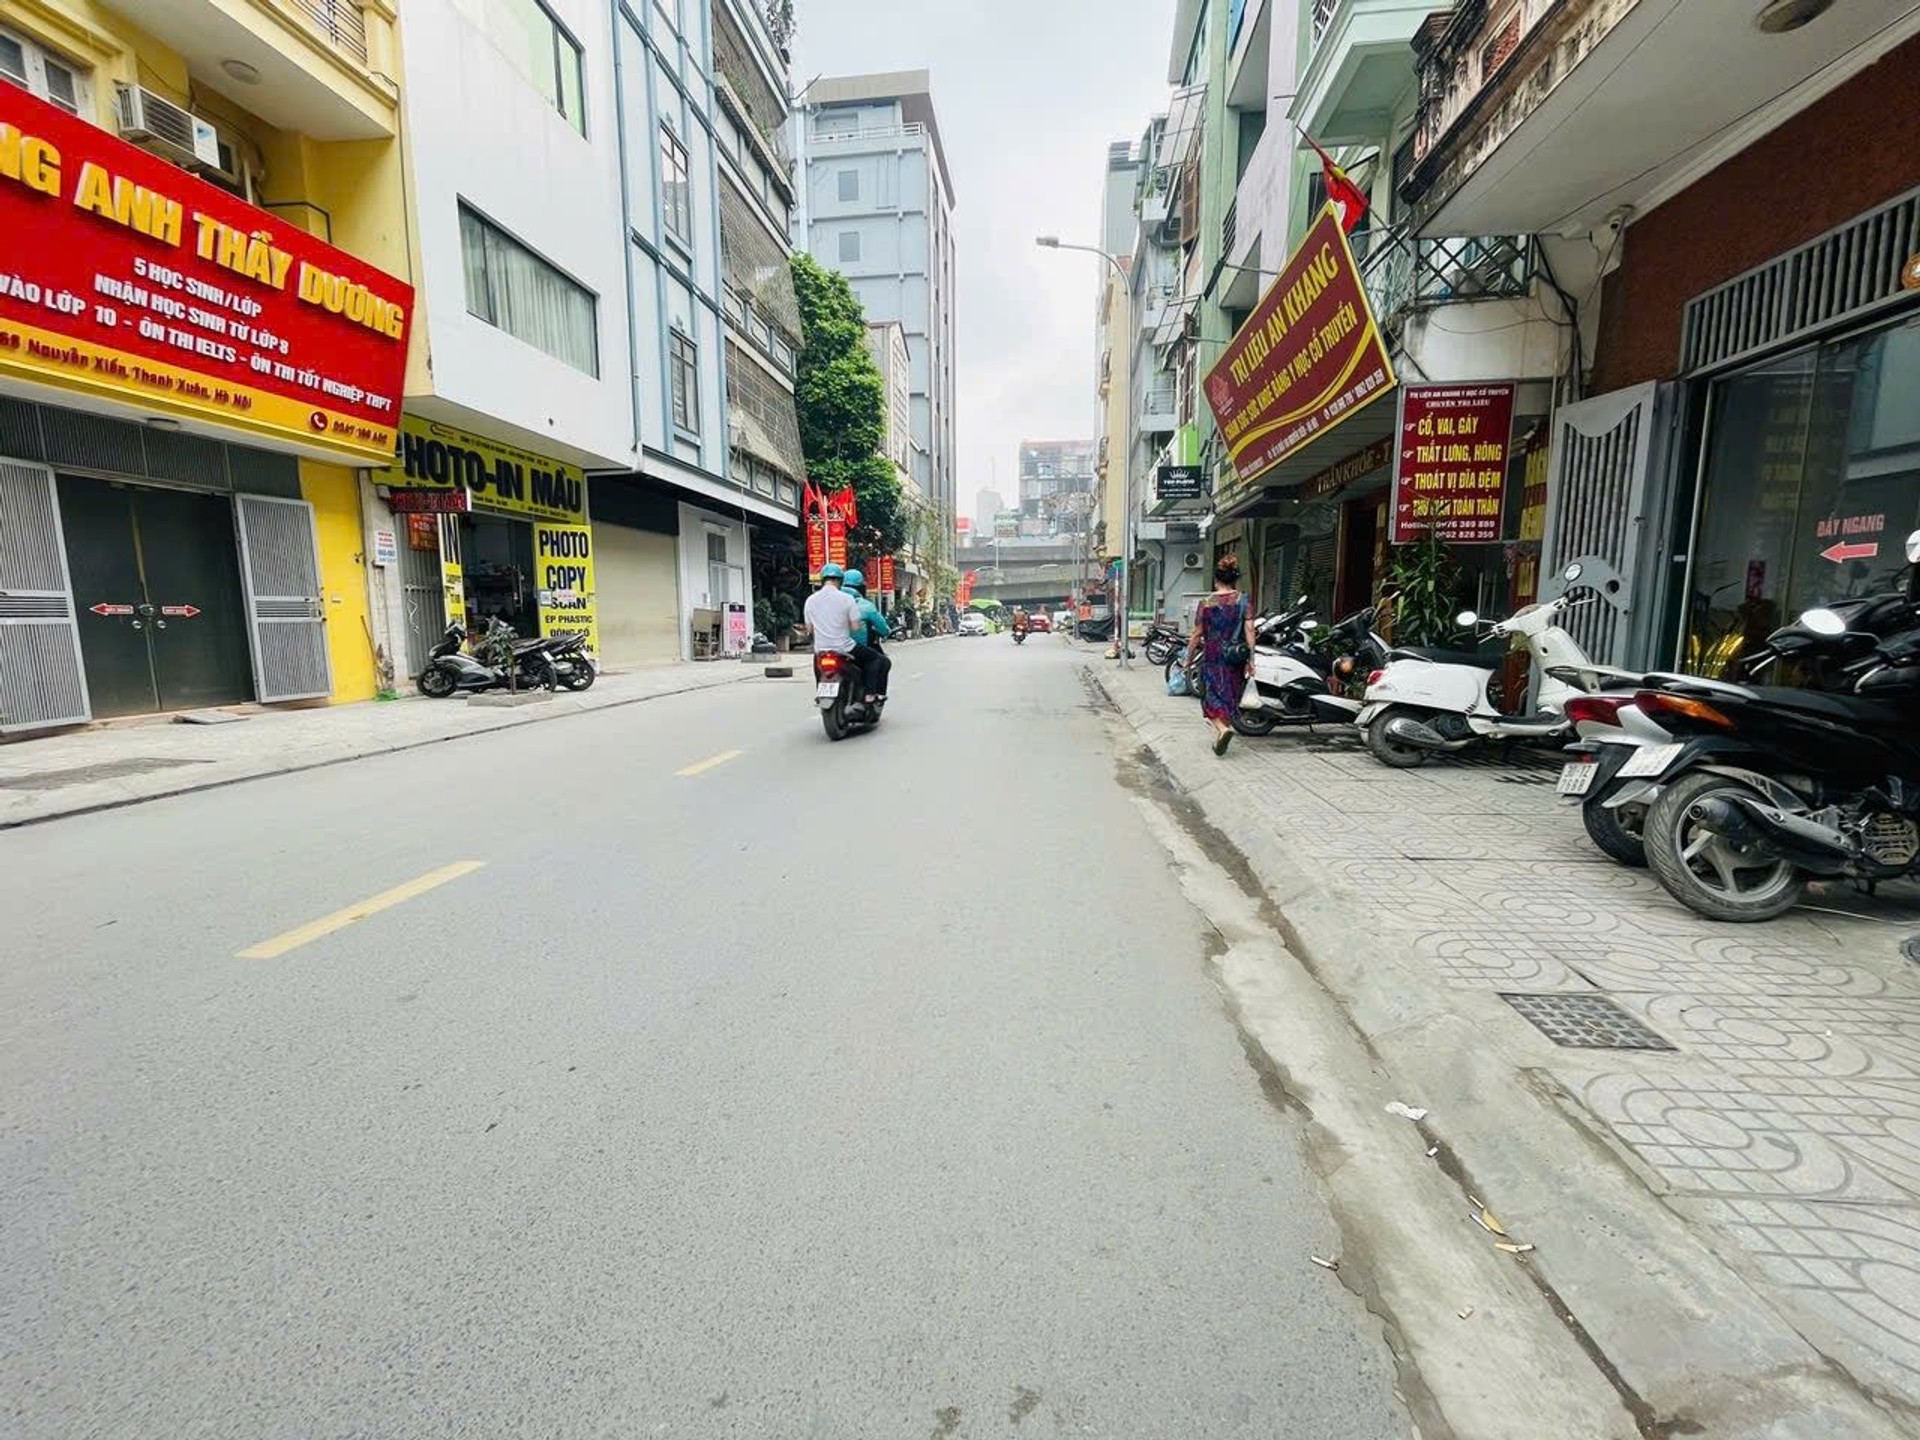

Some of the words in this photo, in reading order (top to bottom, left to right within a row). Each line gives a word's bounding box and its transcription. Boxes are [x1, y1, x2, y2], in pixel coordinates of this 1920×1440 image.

[74, 161, 183, 247] ANH
[193, 212, 293, 290] THẦY
[134, 257, 147, 276] 5
[148, 264, 183, 289] HỌC
[94, 273, 148, 308] NHẬN
[151, 294, 186, 318] HỌC
[188, 309, 227, 331] SINH
[277, 338, 290, 354] 8
[1229, 350, 1250, 387] TRỊ
[1247, 326, 1270, 372] LIỆU
[1267, 318, 1288, 348] AN
[1283, 241, 1339, 327] KHANG
[94, 305, 117, 327] 10
[139, 317, 165, 342] ÔN
[168, 328, 194, 350] THI
[195, 335, 236, 363] IELTS
[274, 363, 295, 383] THI
[1437, 417, 1456, 436] VAI,
[1841, 514, 1886, 535] NGANG
[539, 529, 589, 559] PHOTO
[546, 564, 587, 593] COPY
